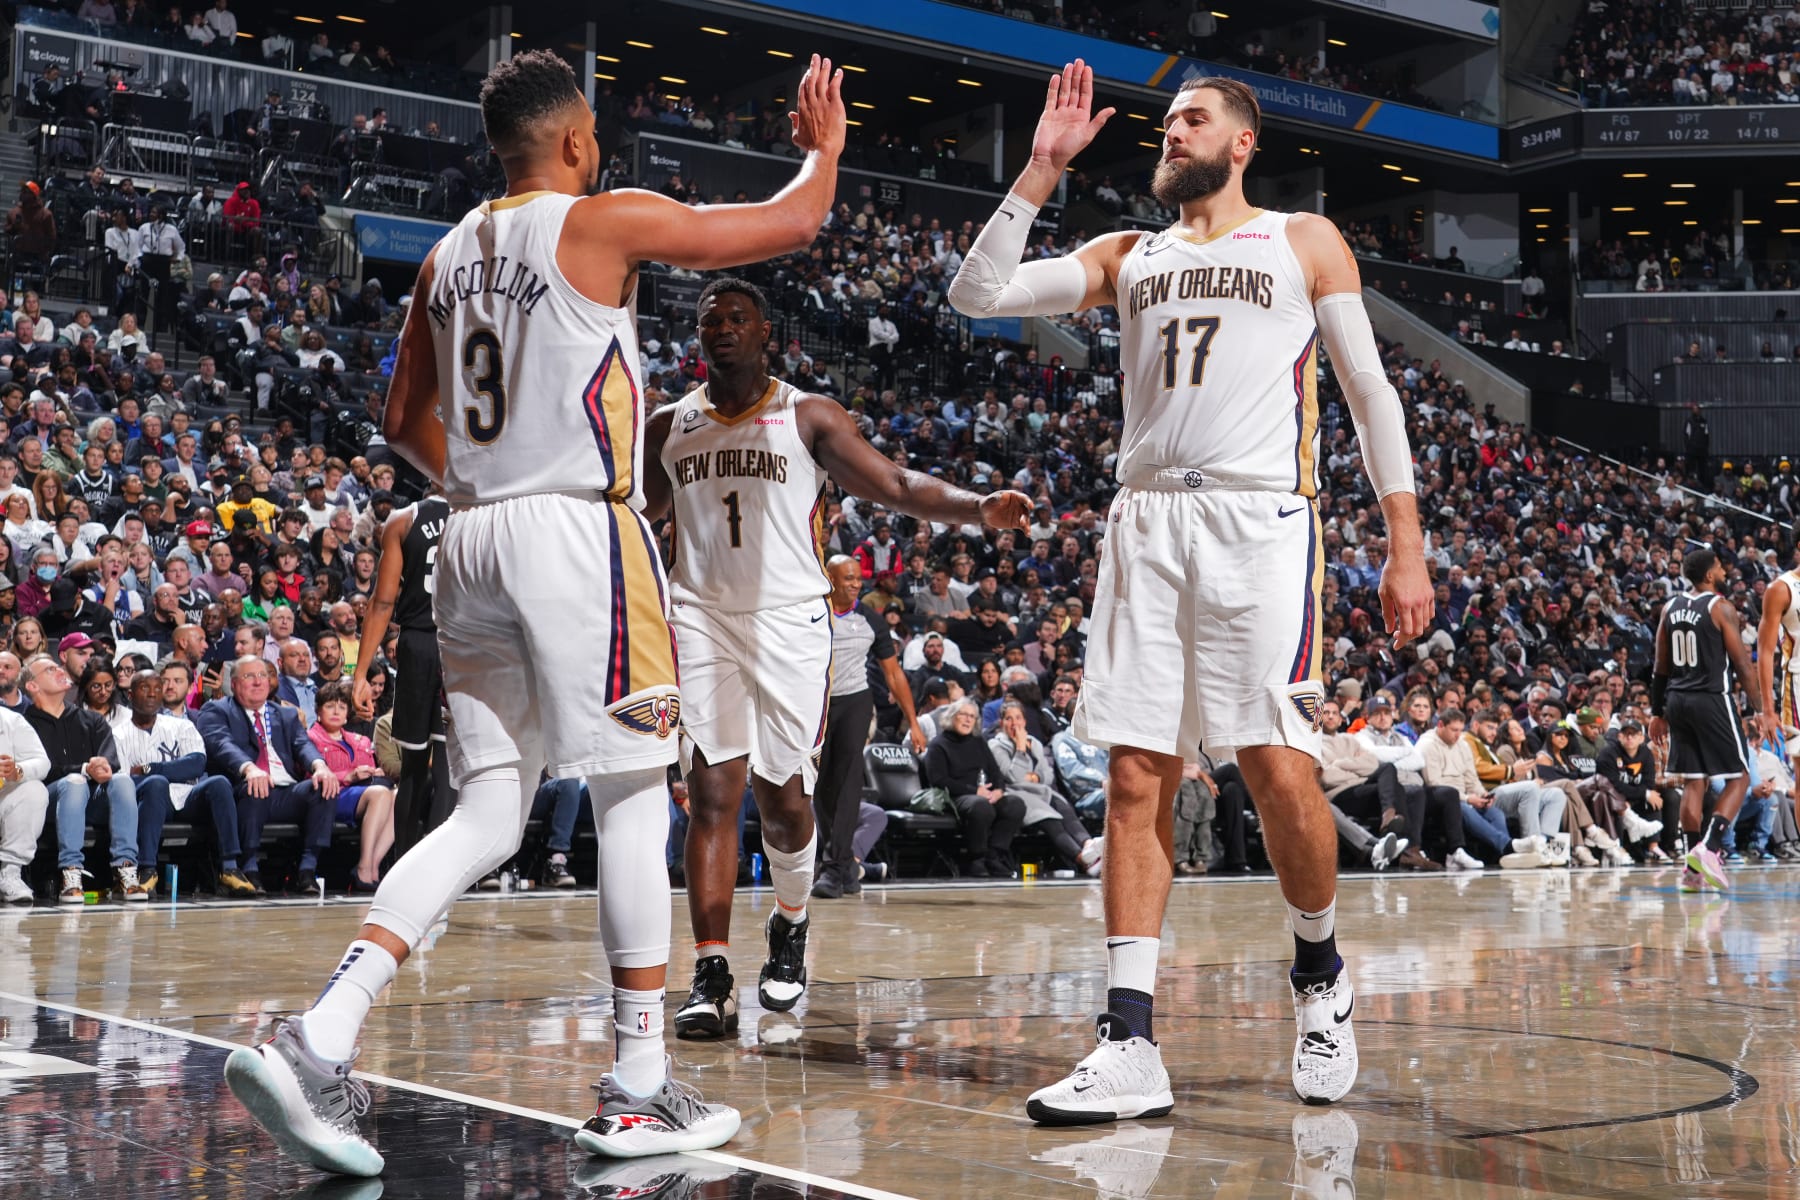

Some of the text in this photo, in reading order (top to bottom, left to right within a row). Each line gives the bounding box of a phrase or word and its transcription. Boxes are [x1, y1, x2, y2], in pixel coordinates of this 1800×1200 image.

[39, 51, 70, 65] clover
[291, 88, 316, 104] 124
[1303, 93, 1346, 117] Health
[1611, 114, 1631, 126] FG
[1676, 112, 1702, 125] 3PT
[1748, 111, 1765, 123] FT
[1521, 127, 1562, 149] 9:34 PM
[880, 188, 901, 201] 125
[1232, 232, 1271, 240] ibotta
[389, 240, 422, 255] Health
[1130, 266, 1274, 318] NEW ORLEANS
[1158, 315, 1221, 391] 17
[463, 327, 507, 447] 3
[754, 417, 784, 425] ibotta
[674, 448, 788, 489] NEW ORLEANS
[721, 490, 743, 549] 1
[1672, 629, 1698, 667] 00
[871, 746, 911, 760] QATAR
